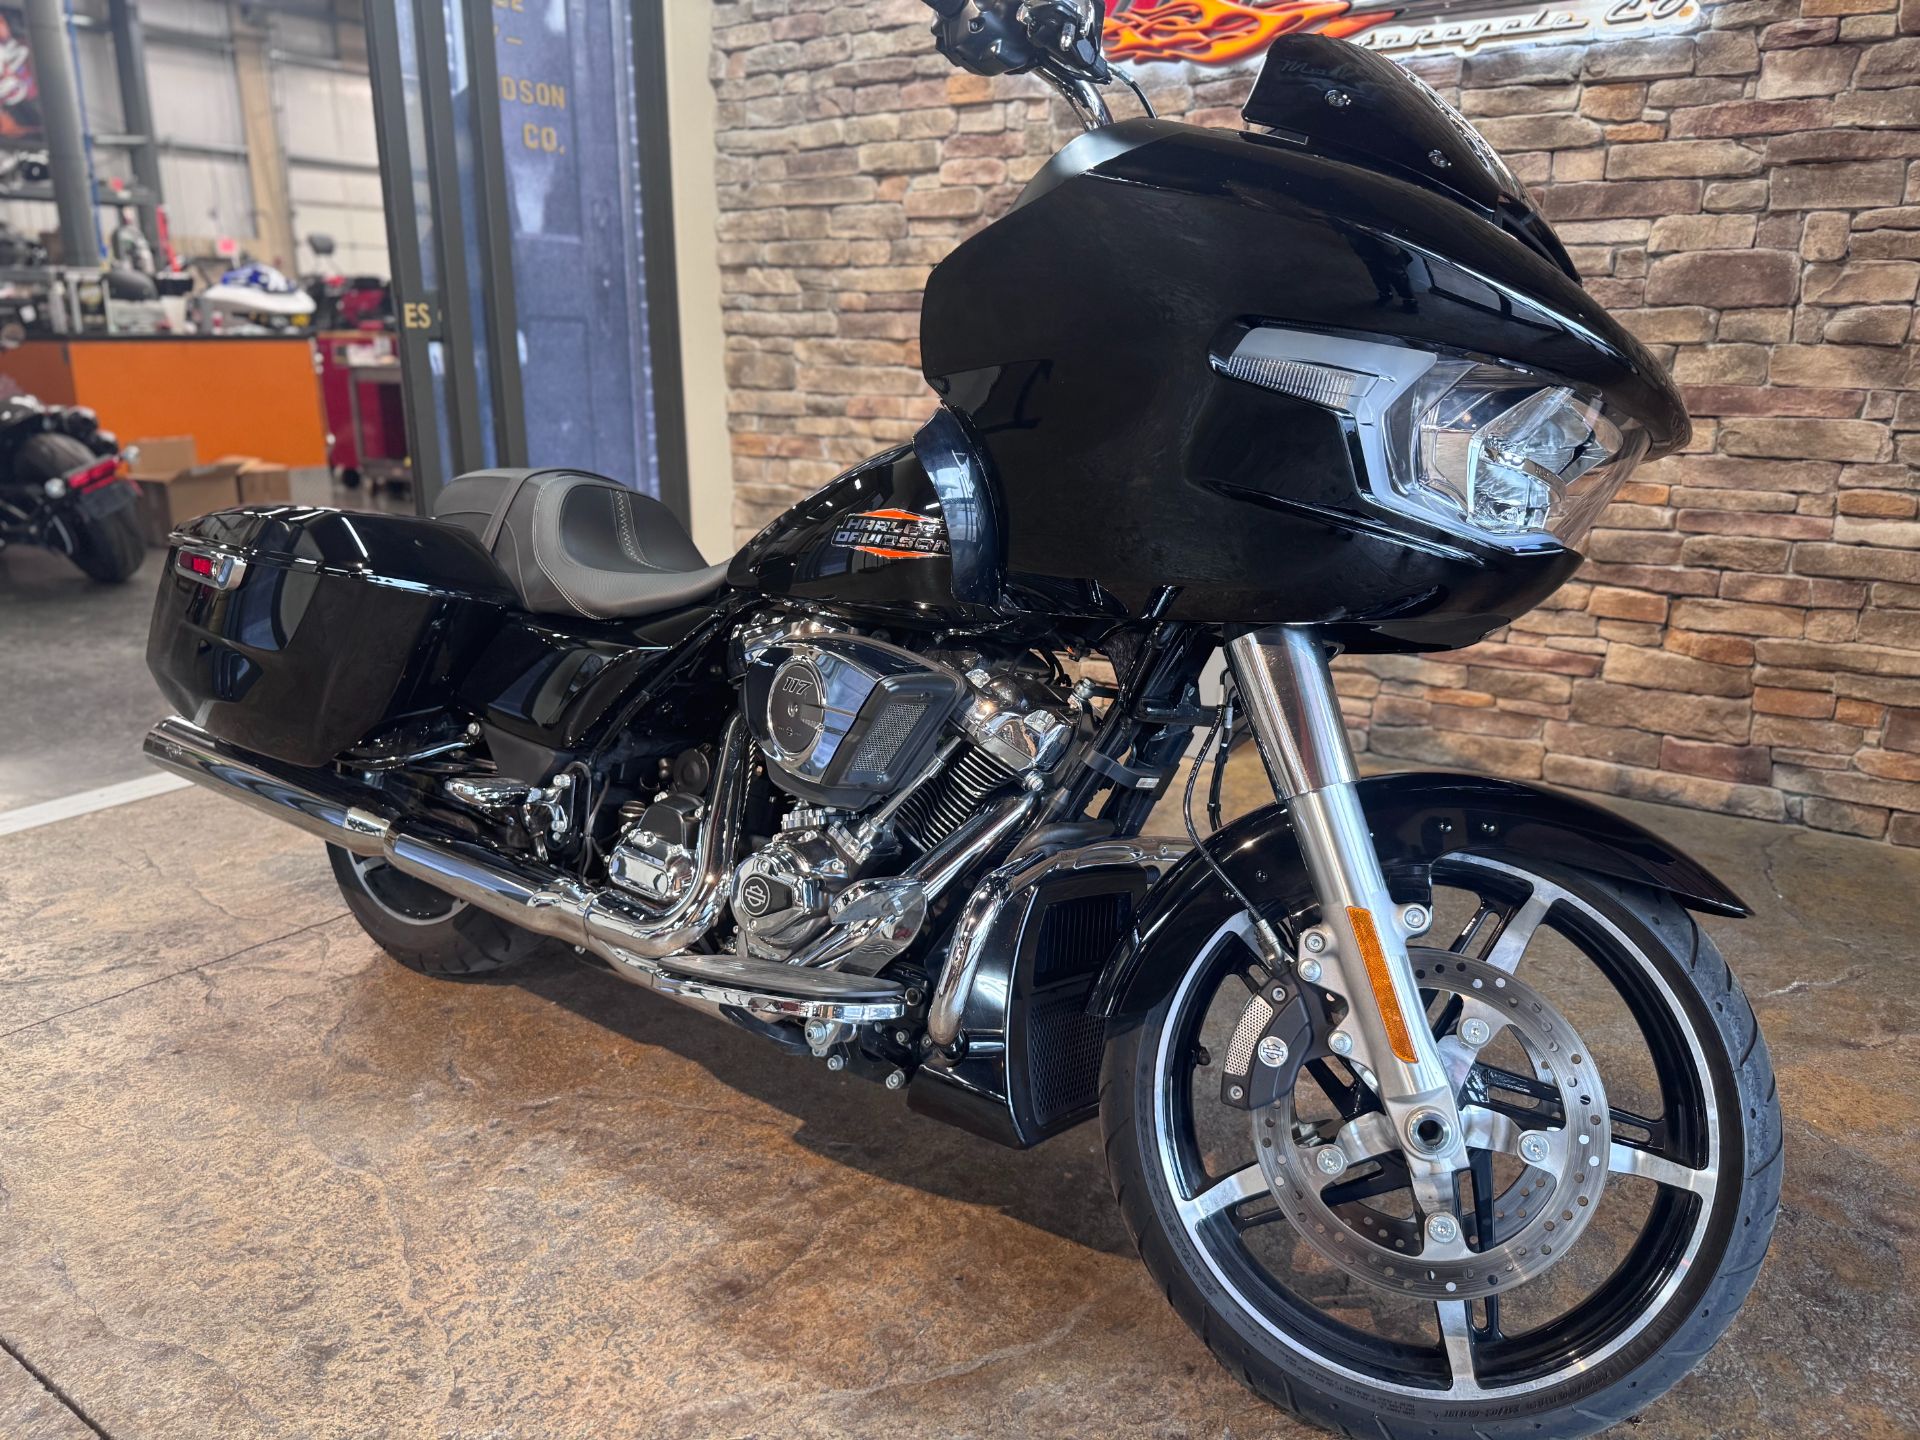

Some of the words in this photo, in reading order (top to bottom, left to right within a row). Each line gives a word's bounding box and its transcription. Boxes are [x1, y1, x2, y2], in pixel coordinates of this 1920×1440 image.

[501, 76, 567, 110] DSON
[523, 122, 566, 156] CO.
[403, 302, 432, 329] ES
[782, 676, 814, 695] 117
